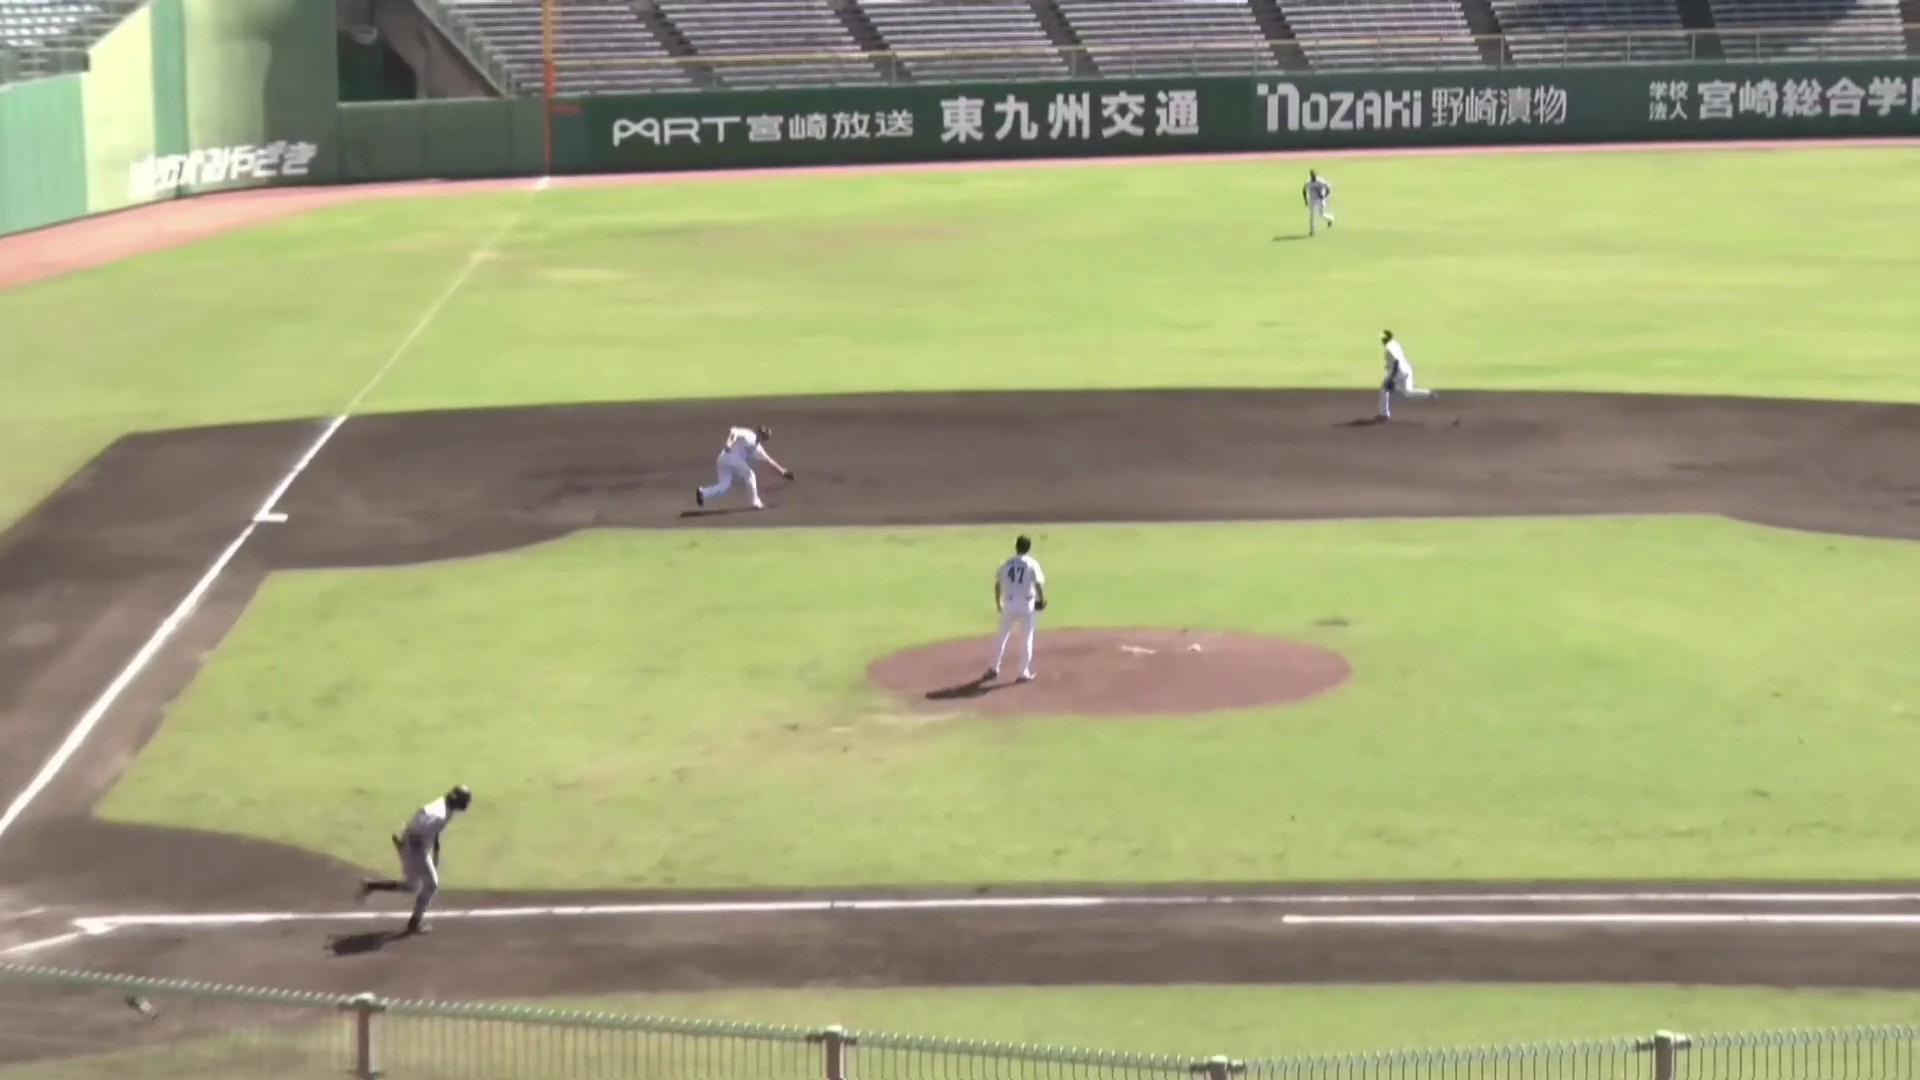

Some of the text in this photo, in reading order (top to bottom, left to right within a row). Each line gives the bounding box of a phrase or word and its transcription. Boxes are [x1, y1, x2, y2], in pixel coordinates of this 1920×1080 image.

[1649, 80, 1688, 100] 学校
[940, 89, 1199, 143] 東九州交通
[1431, 84, 1568, 127] 野崎漬物
[1649, 101, 1688, 121] 法人
[746, 108, 914, 142] 宮崎放送
[1007, 566, 1025, 584] 47
